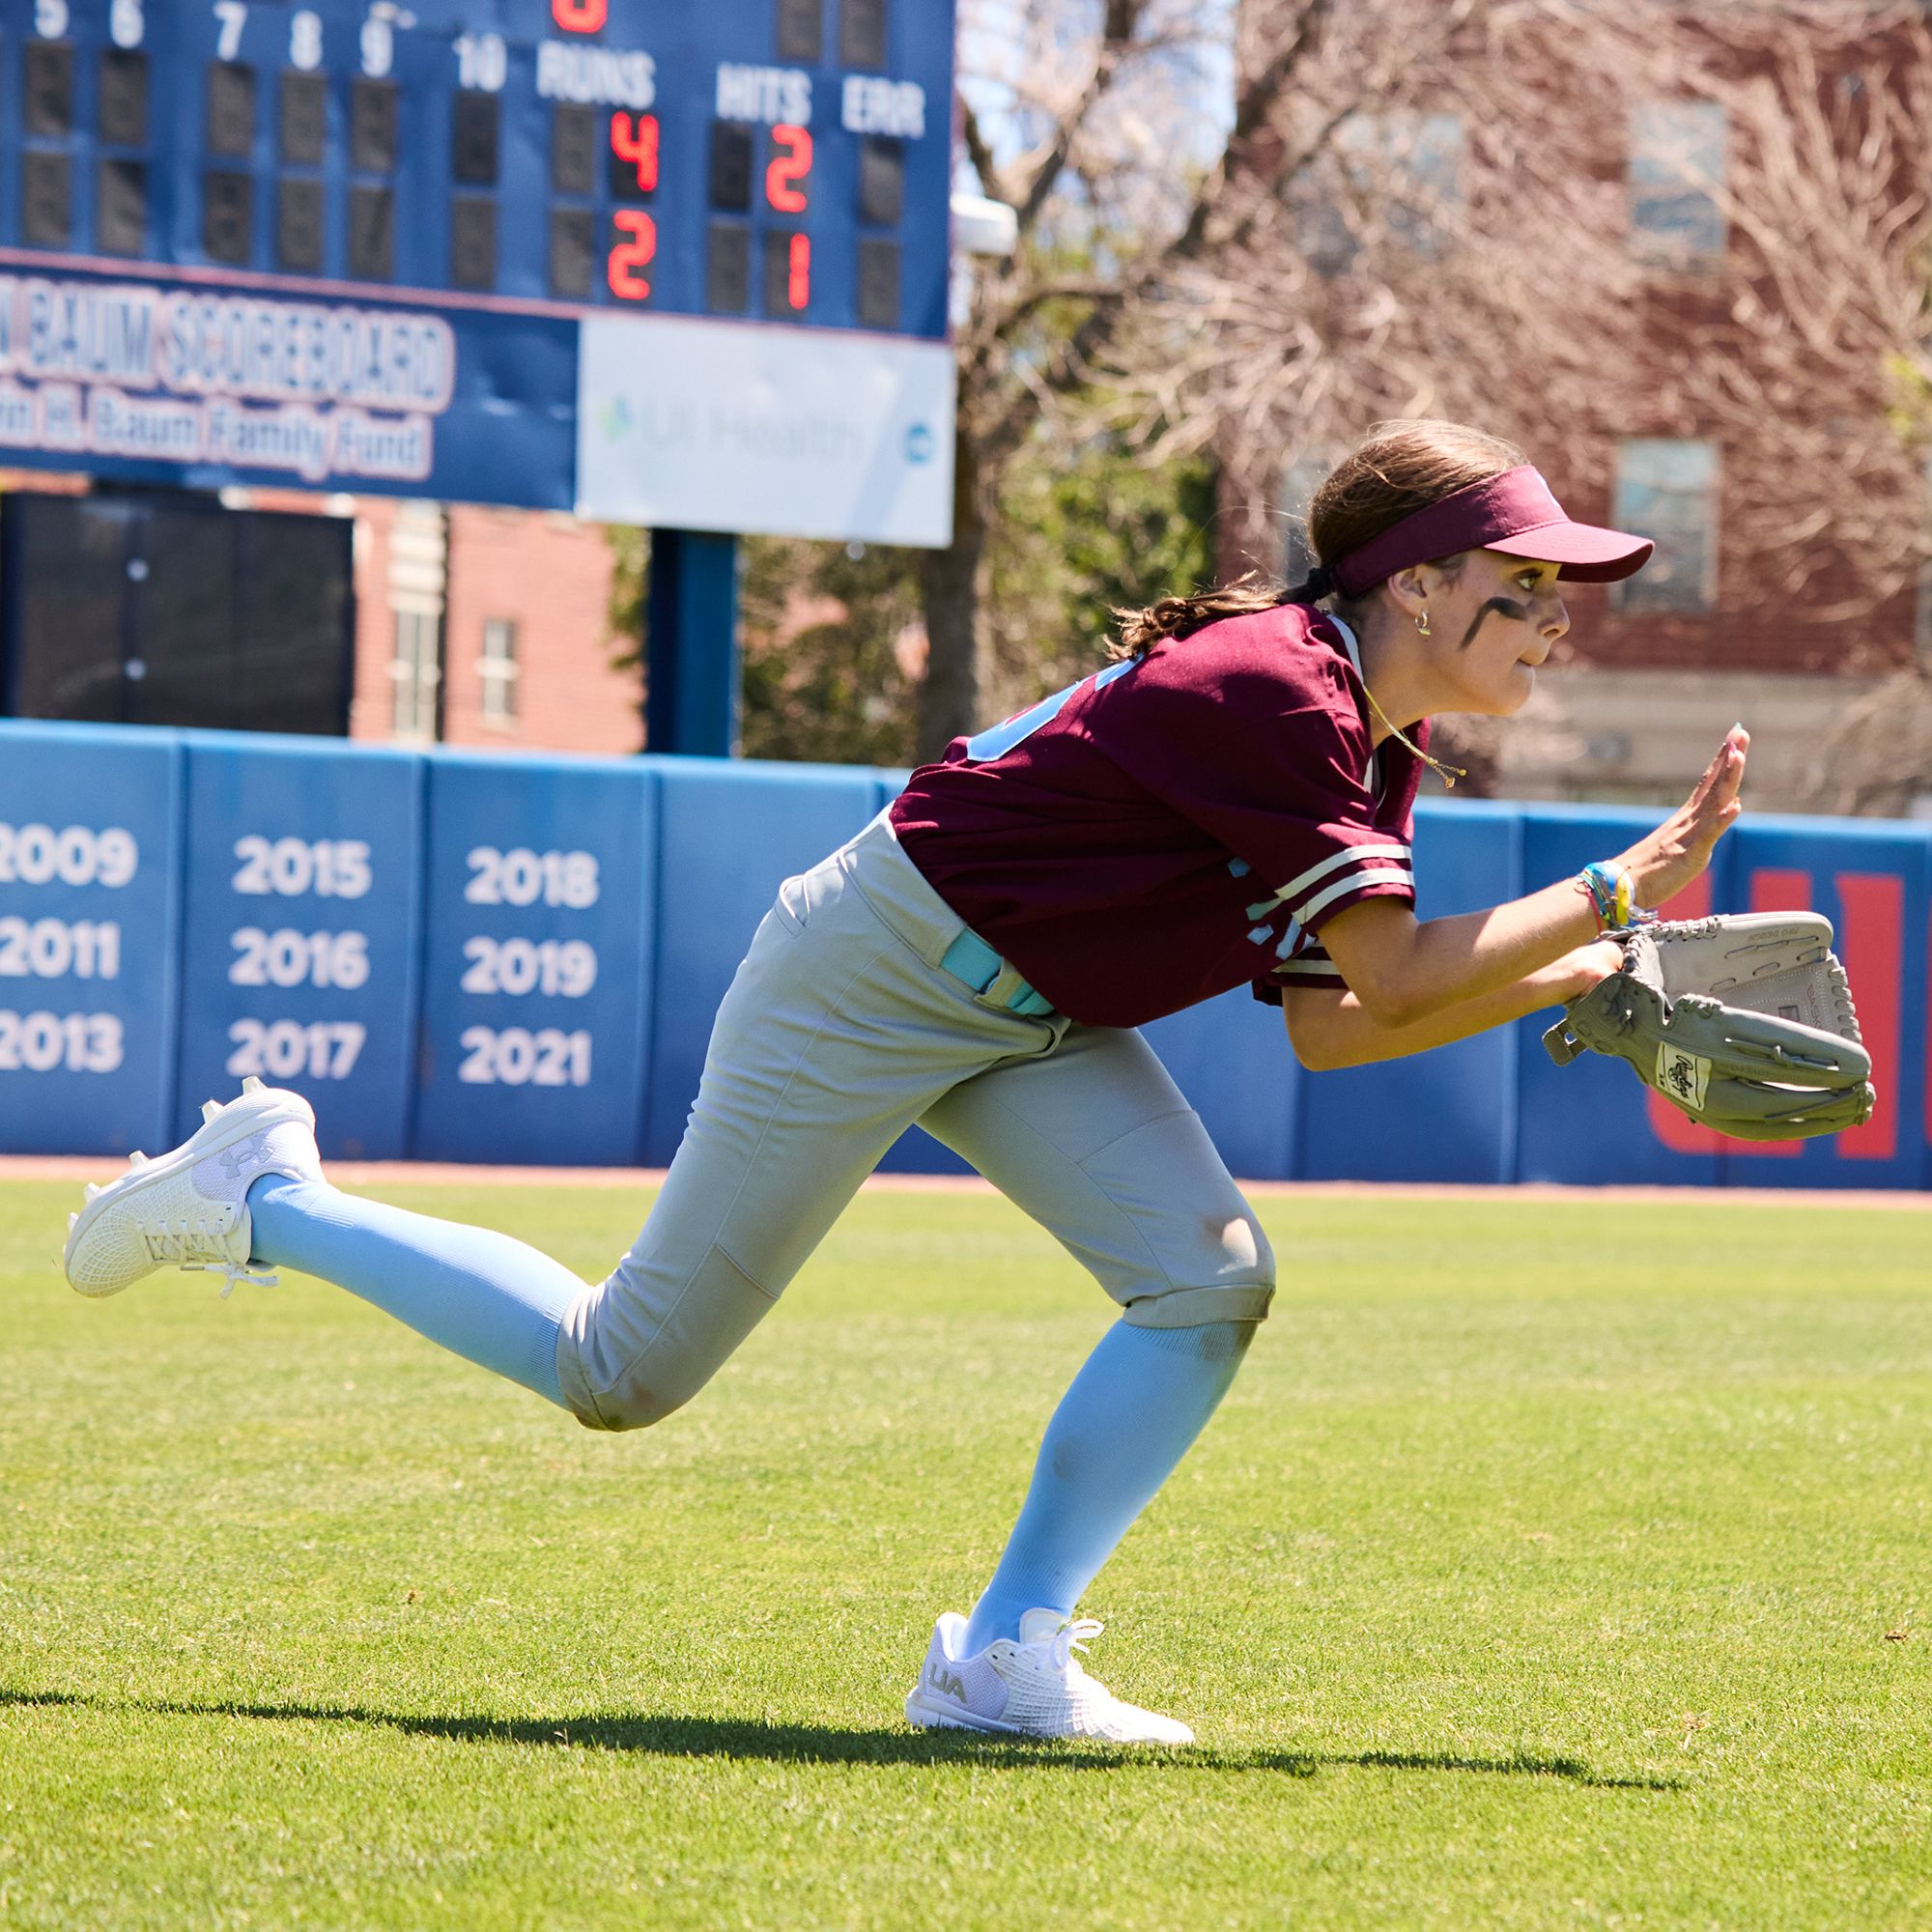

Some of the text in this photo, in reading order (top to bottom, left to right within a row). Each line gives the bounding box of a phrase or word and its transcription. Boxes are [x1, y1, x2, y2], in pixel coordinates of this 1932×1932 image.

[110, 0, 144, 48] 6
[213, 1, 247, 61] 7
[291, 11, 323, 71] 8
[359, 17, 394, 77] 9
[453, 34, 506, 92] 10
[536, 41, 656, 109] RUNS
[715, 62, 812, 128] HITS
[842, 73, 924, 139] ERR
[611, 111, 812, 213] 4 2
[608, 210, 810, 309] 2 1
[25, 281, 157, 381] BAUM
[163, 293, 452, 410] SCOREBOARD
[92, 393, 199, 452] Baum
[206, 400, 329, 476] Family
[334, 411, 428, 473] Fund
[233, 836, 372, 899] 2015
[465, 847, 599, 909] 2018
[0, 917, 121, 980] 2011
[230, 927, 370, 989] 2016
[462, 937, 597, 998] 2019
[0, 1009, 124, 1073] 2013
[227, 1019, 366, 1079] 2017
[459, 1027, 592, 1086] 2021
